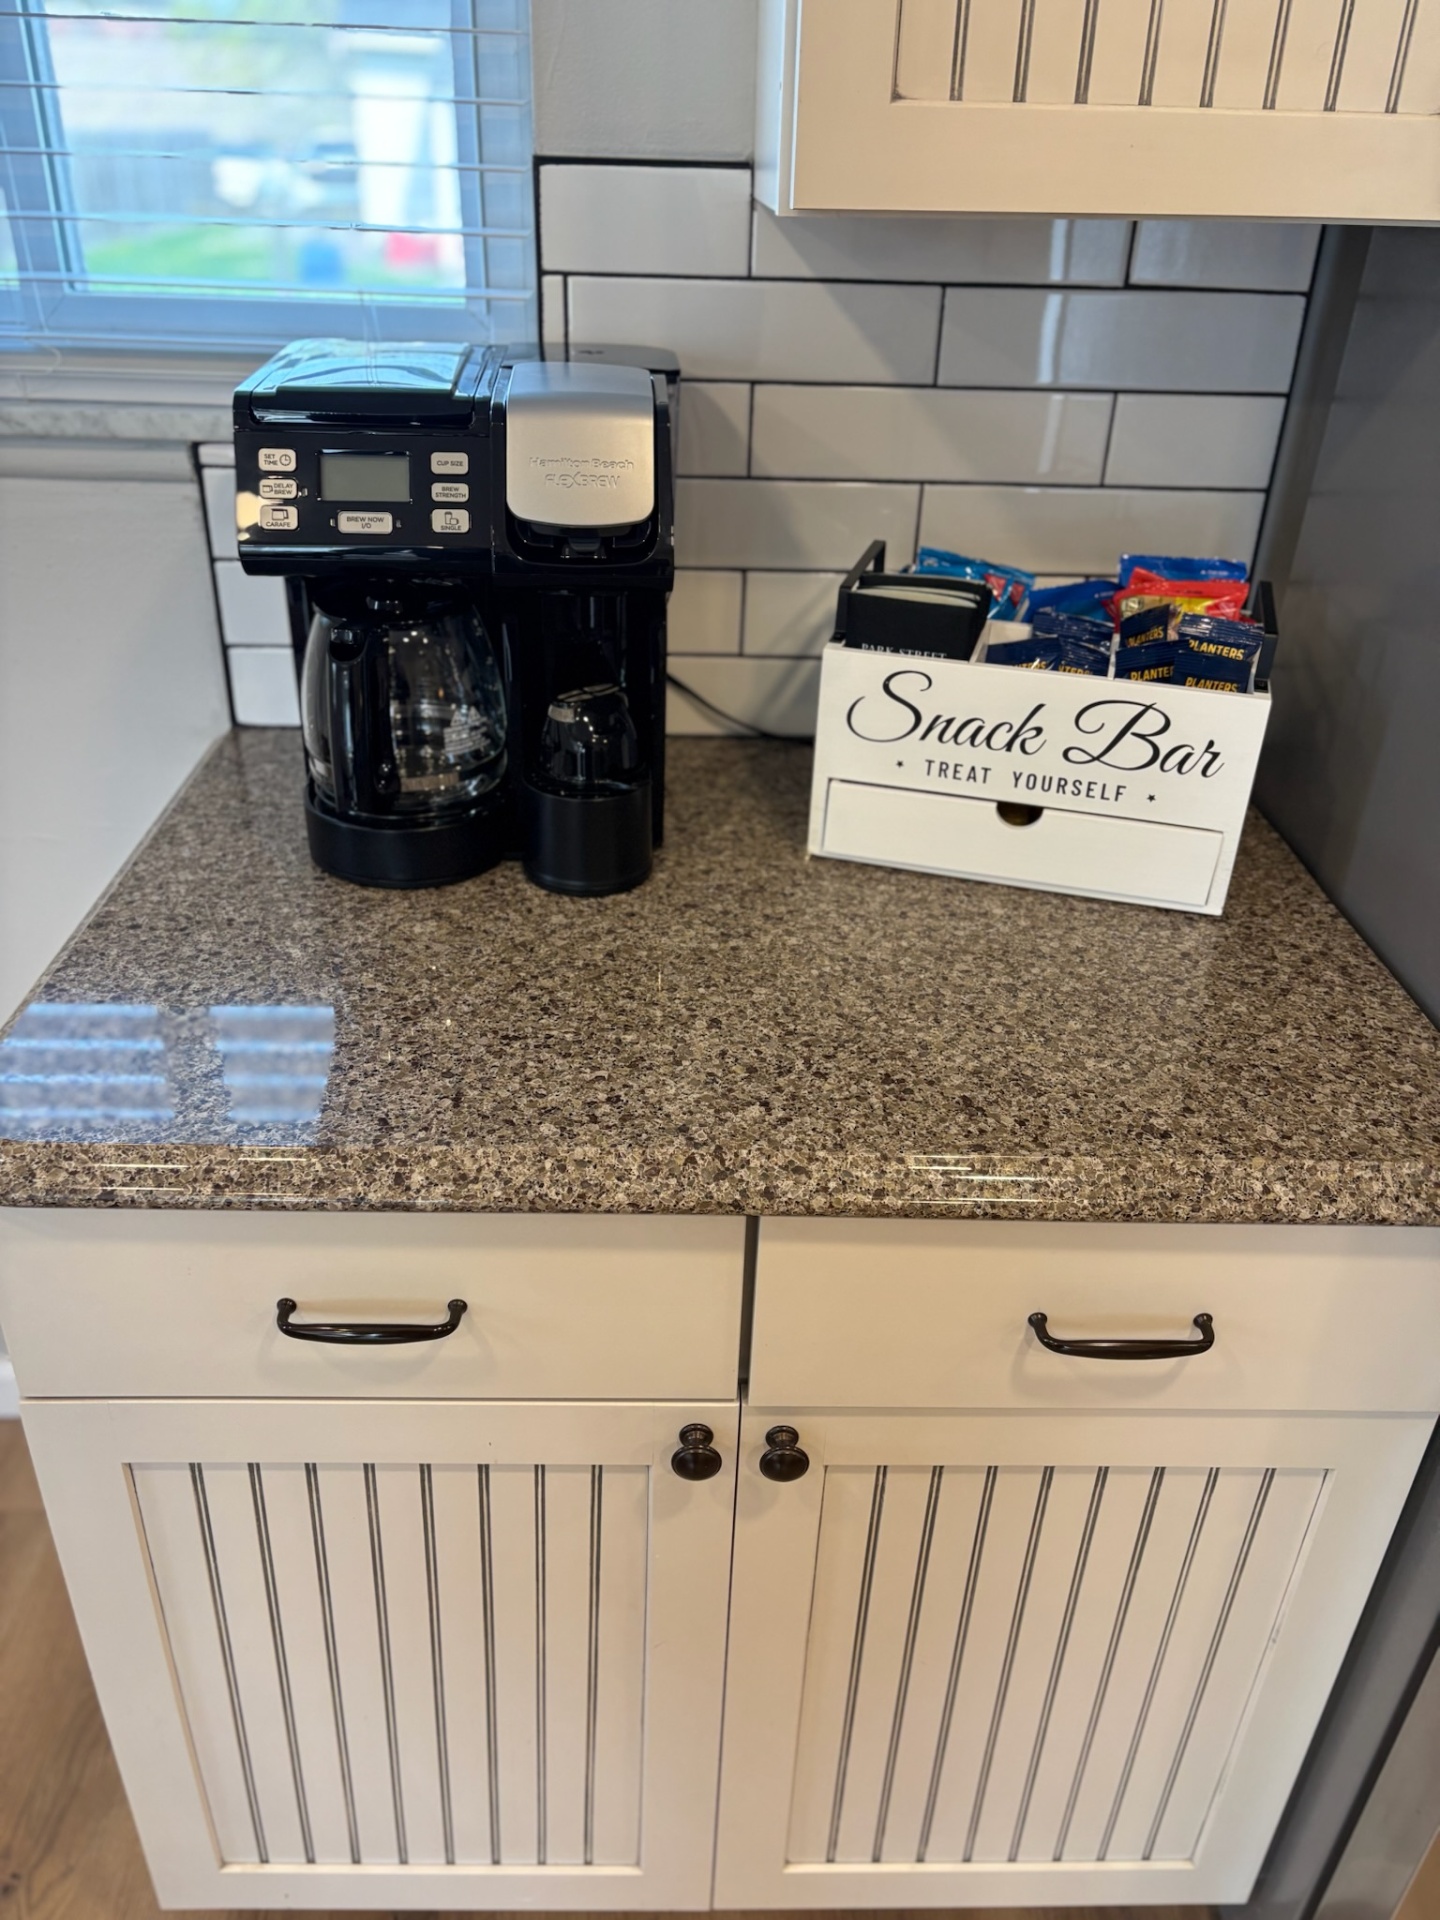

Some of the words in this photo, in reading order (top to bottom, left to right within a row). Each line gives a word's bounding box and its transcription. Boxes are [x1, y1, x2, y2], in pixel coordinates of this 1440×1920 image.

[529, 456, 590, 468] Hamilton
[591, 457, 634, 470] Beach
[1188, 638, 1245, 661] PLANTERS
[1130, 665, 1175, 682] PLANTE
[846, 669, 1048, 756] Snack
[1062, 699, 1226, 779] Bar
[924, 759, 992, 785] TREAT
[1013, 771, 1129, 803] YOURSELF
